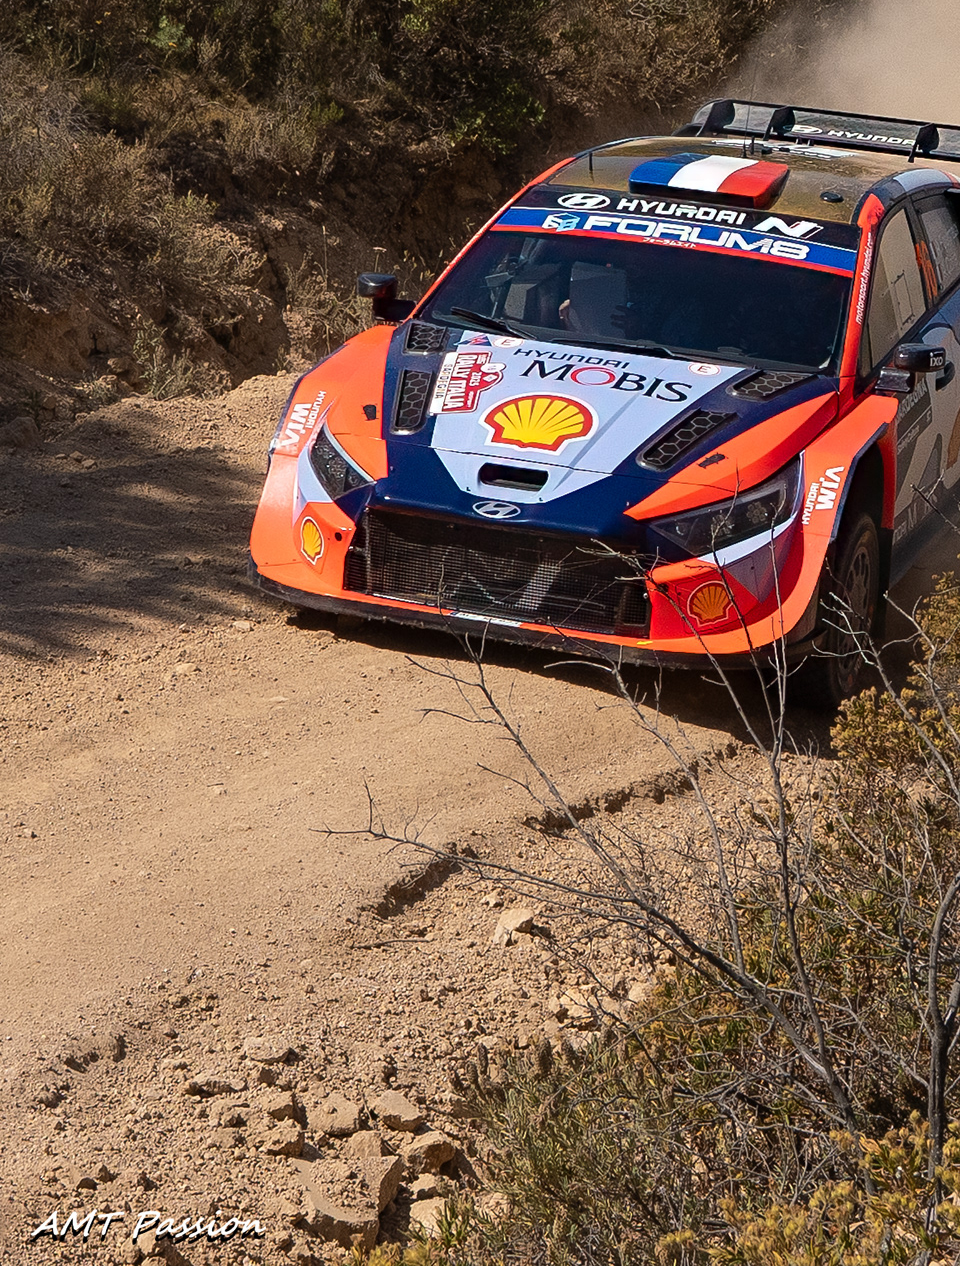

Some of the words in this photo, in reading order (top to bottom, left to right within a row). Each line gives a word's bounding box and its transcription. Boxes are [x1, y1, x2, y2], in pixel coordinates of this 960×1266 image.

[827, 129, 917, 146] HYUNDA
[583, 215, 811, 260] FORUM8
[616, 197, 747, 225] HYUNDAI
[753, 216, 825, 239] N
[452, 353, 478, 379] RALLY
[513, 347, 630, 370] HYUNDAI
[443, 379, 467, 410] ITALIA
[519, 359, 693, 403] MOBIS
[280, 403, 313, 447] WIA
[305, 390, 327, 429] HYUNDAI
[801, 482, 820, 525] HYUNDAI
[815, 466, 845, 510] WIA
